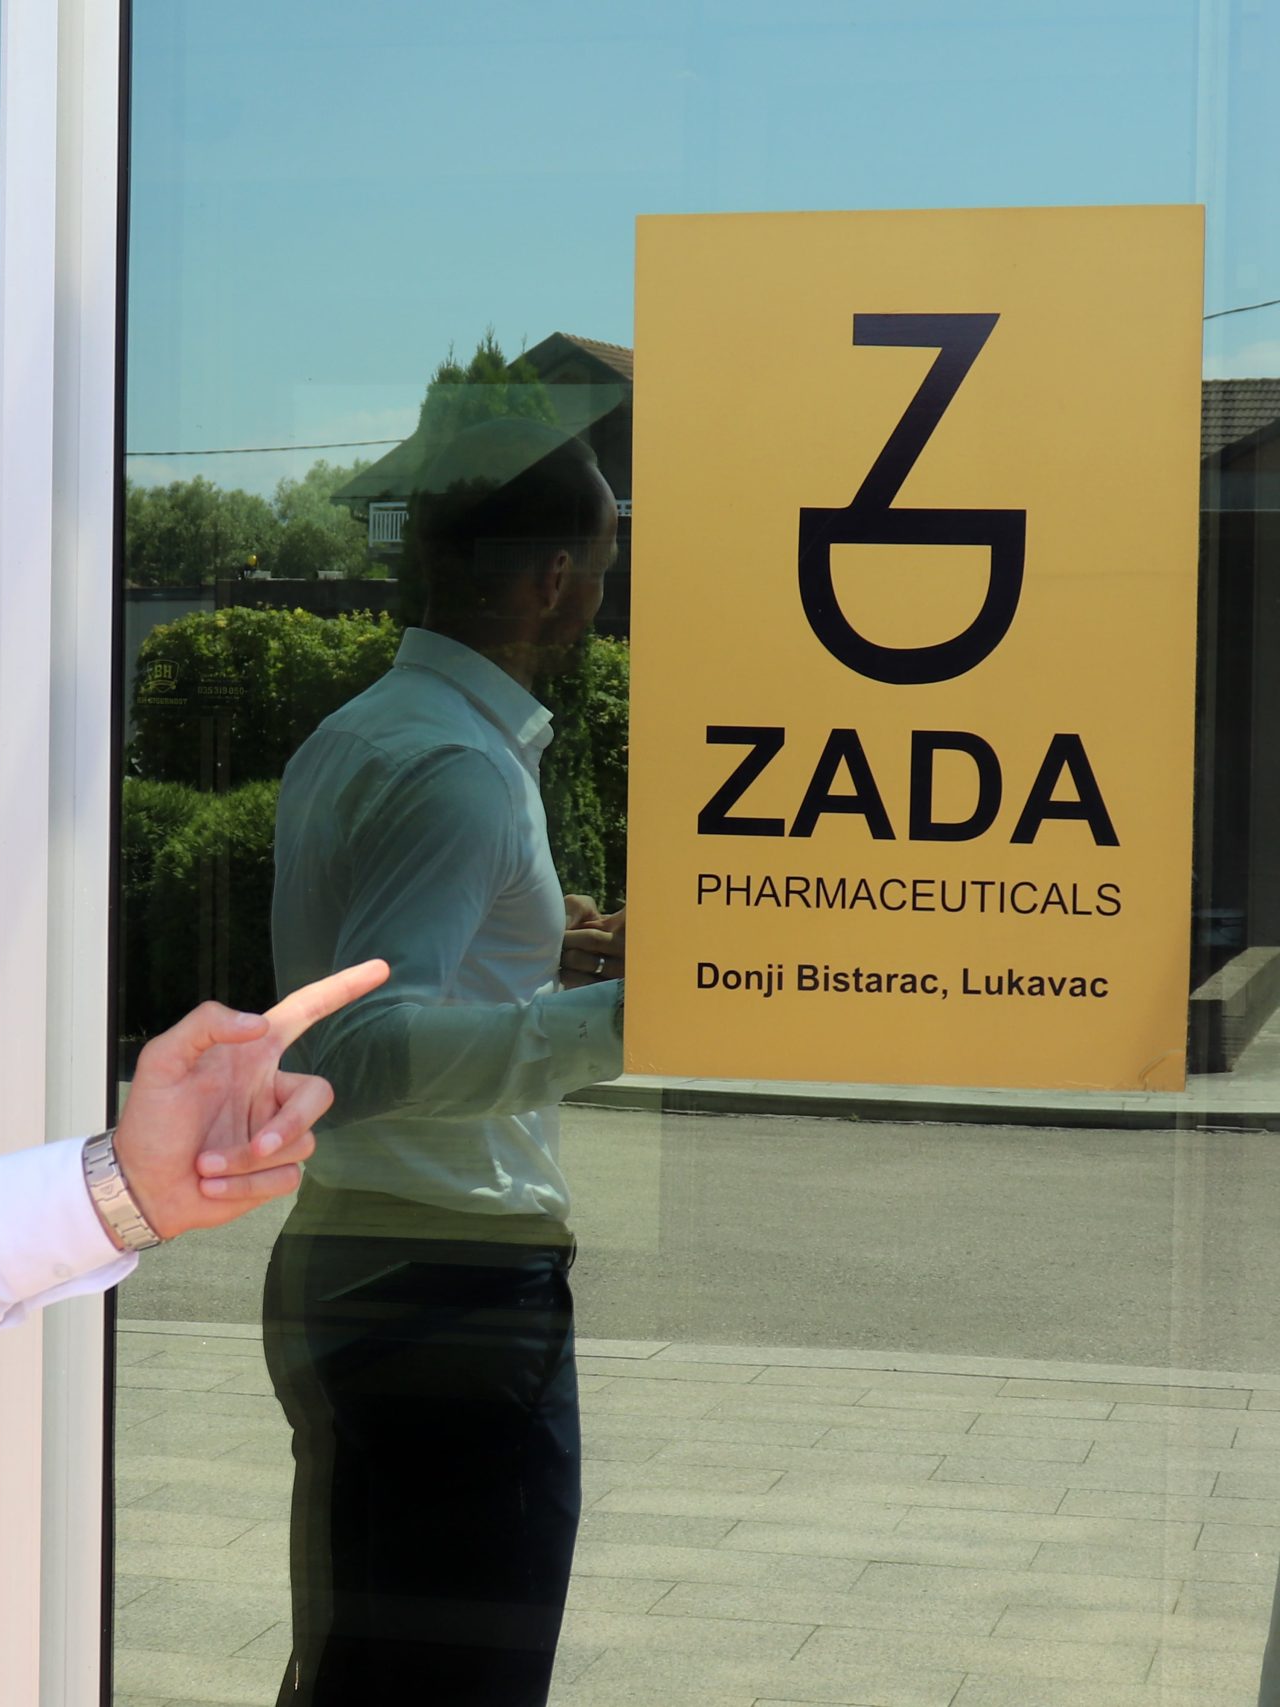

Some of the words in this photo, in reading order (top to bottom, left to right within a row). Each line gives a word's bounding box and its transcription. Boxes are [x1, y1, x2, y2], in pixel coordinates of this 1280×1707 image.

[154, 664, 172, 679] BH
[696, 725, 1121, 847] ZADA
[697, 873, 1122, 917] PHARMACEUTICALS
[696, 961, 784, 999] Donji
[796, 963, 948, 1000] Bistarac,
[961, 967, 1109, 999] Lukavac
